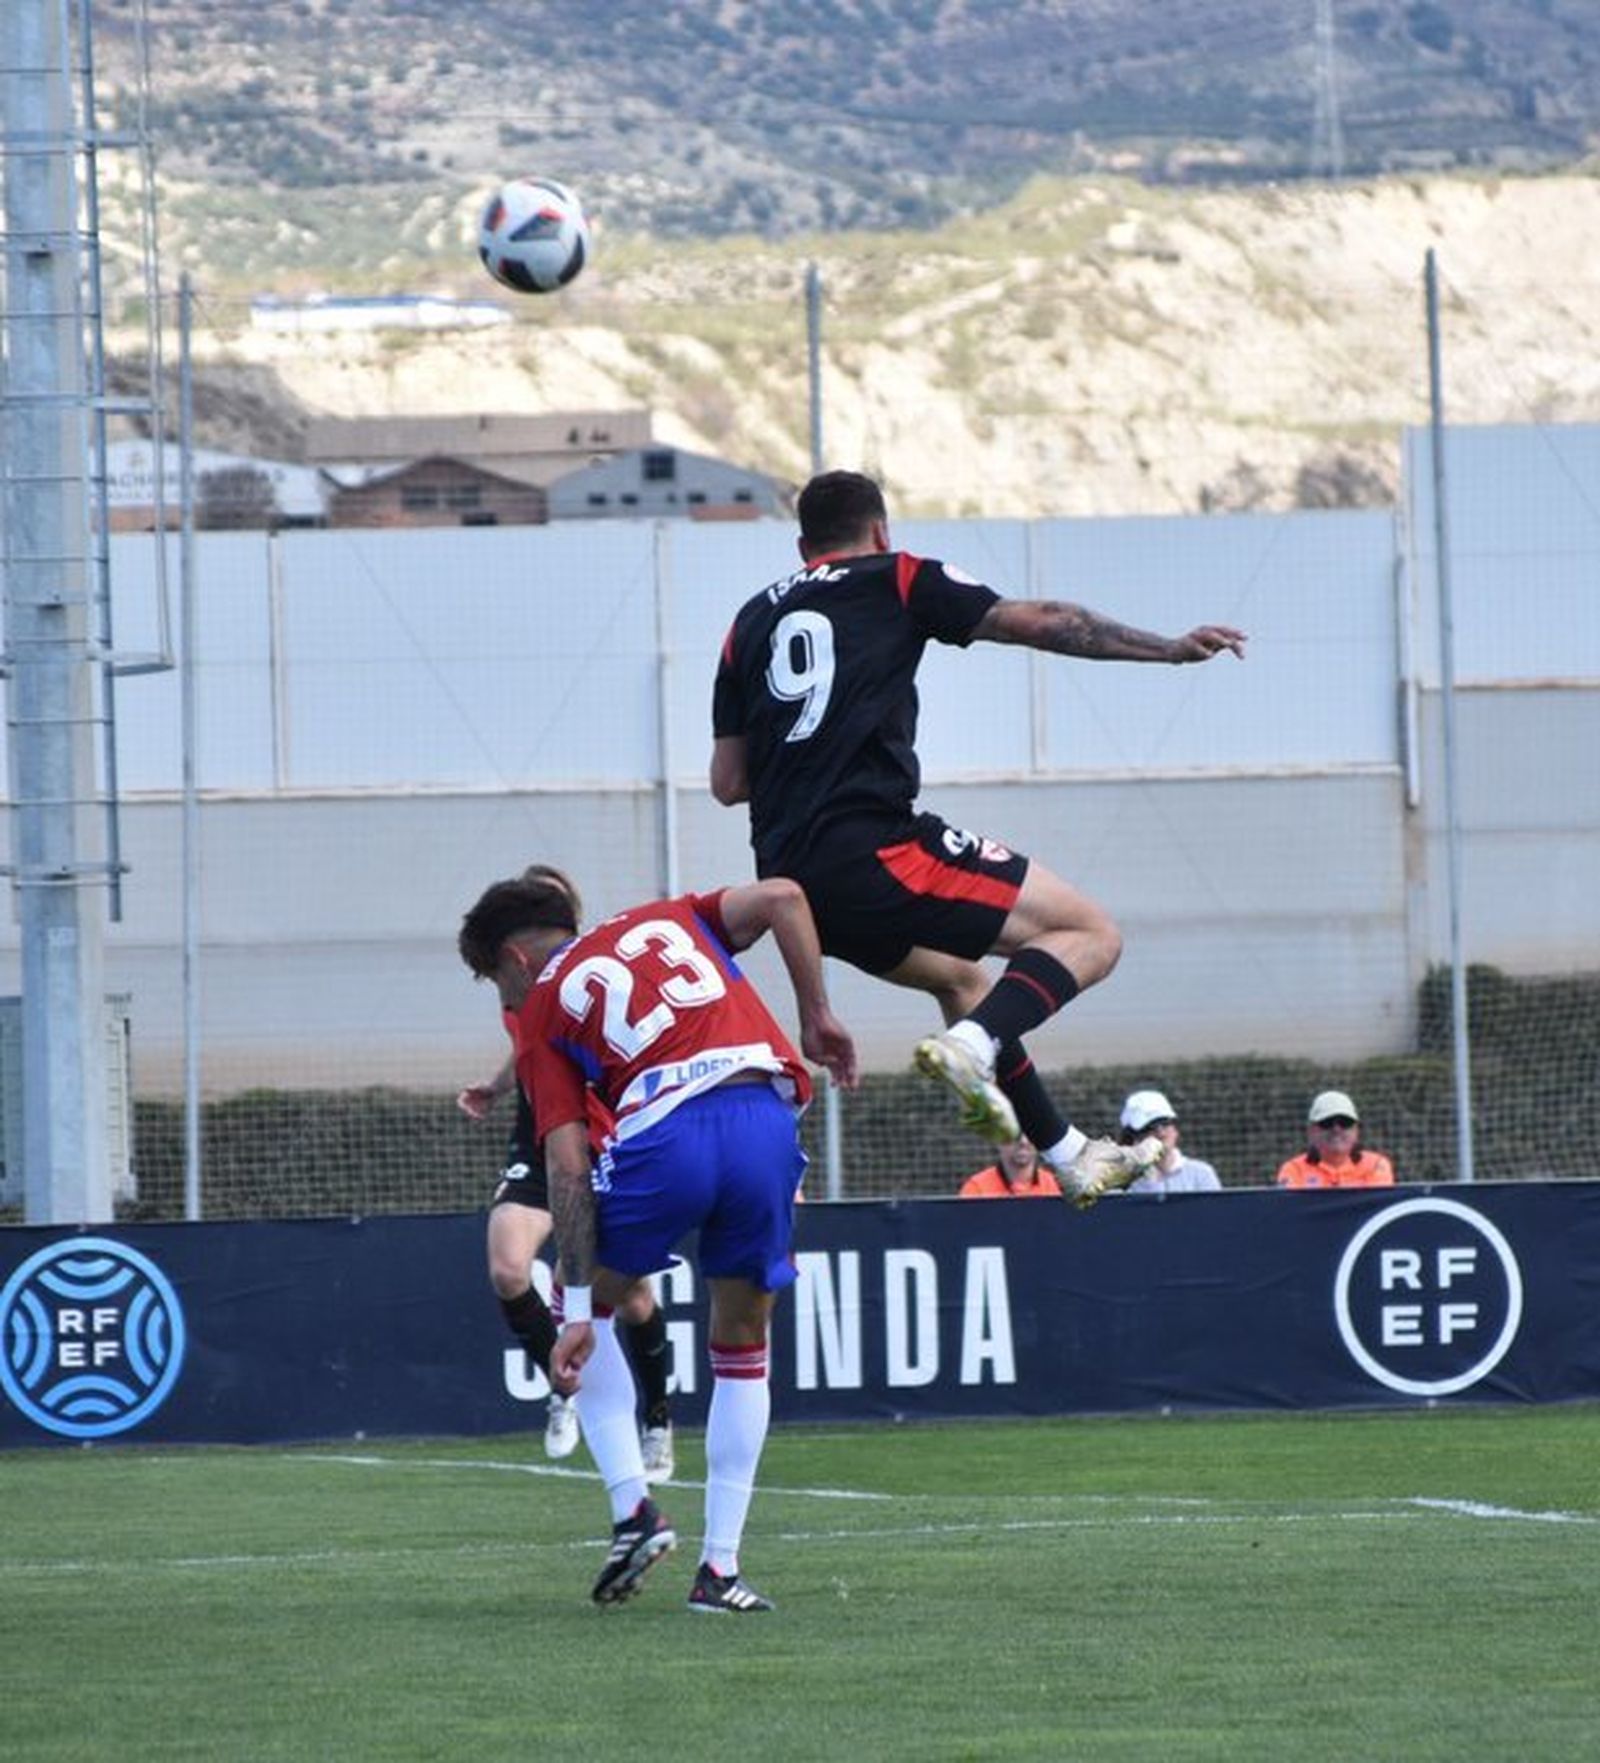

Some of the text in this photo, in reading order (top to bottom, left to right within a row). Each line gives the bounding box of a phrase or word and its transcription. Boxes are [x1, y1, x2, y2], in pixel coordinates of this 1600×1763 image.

[765, 609, 836, 743] 9
[559, 919, 727, 1062] 23
[1380, 1247, 1478, 1291] RF
[58, 1308, 119, 1334] RF
[1381, 1303, 1479, 1346] EF
[58, 1341, 120, 1367] EF
